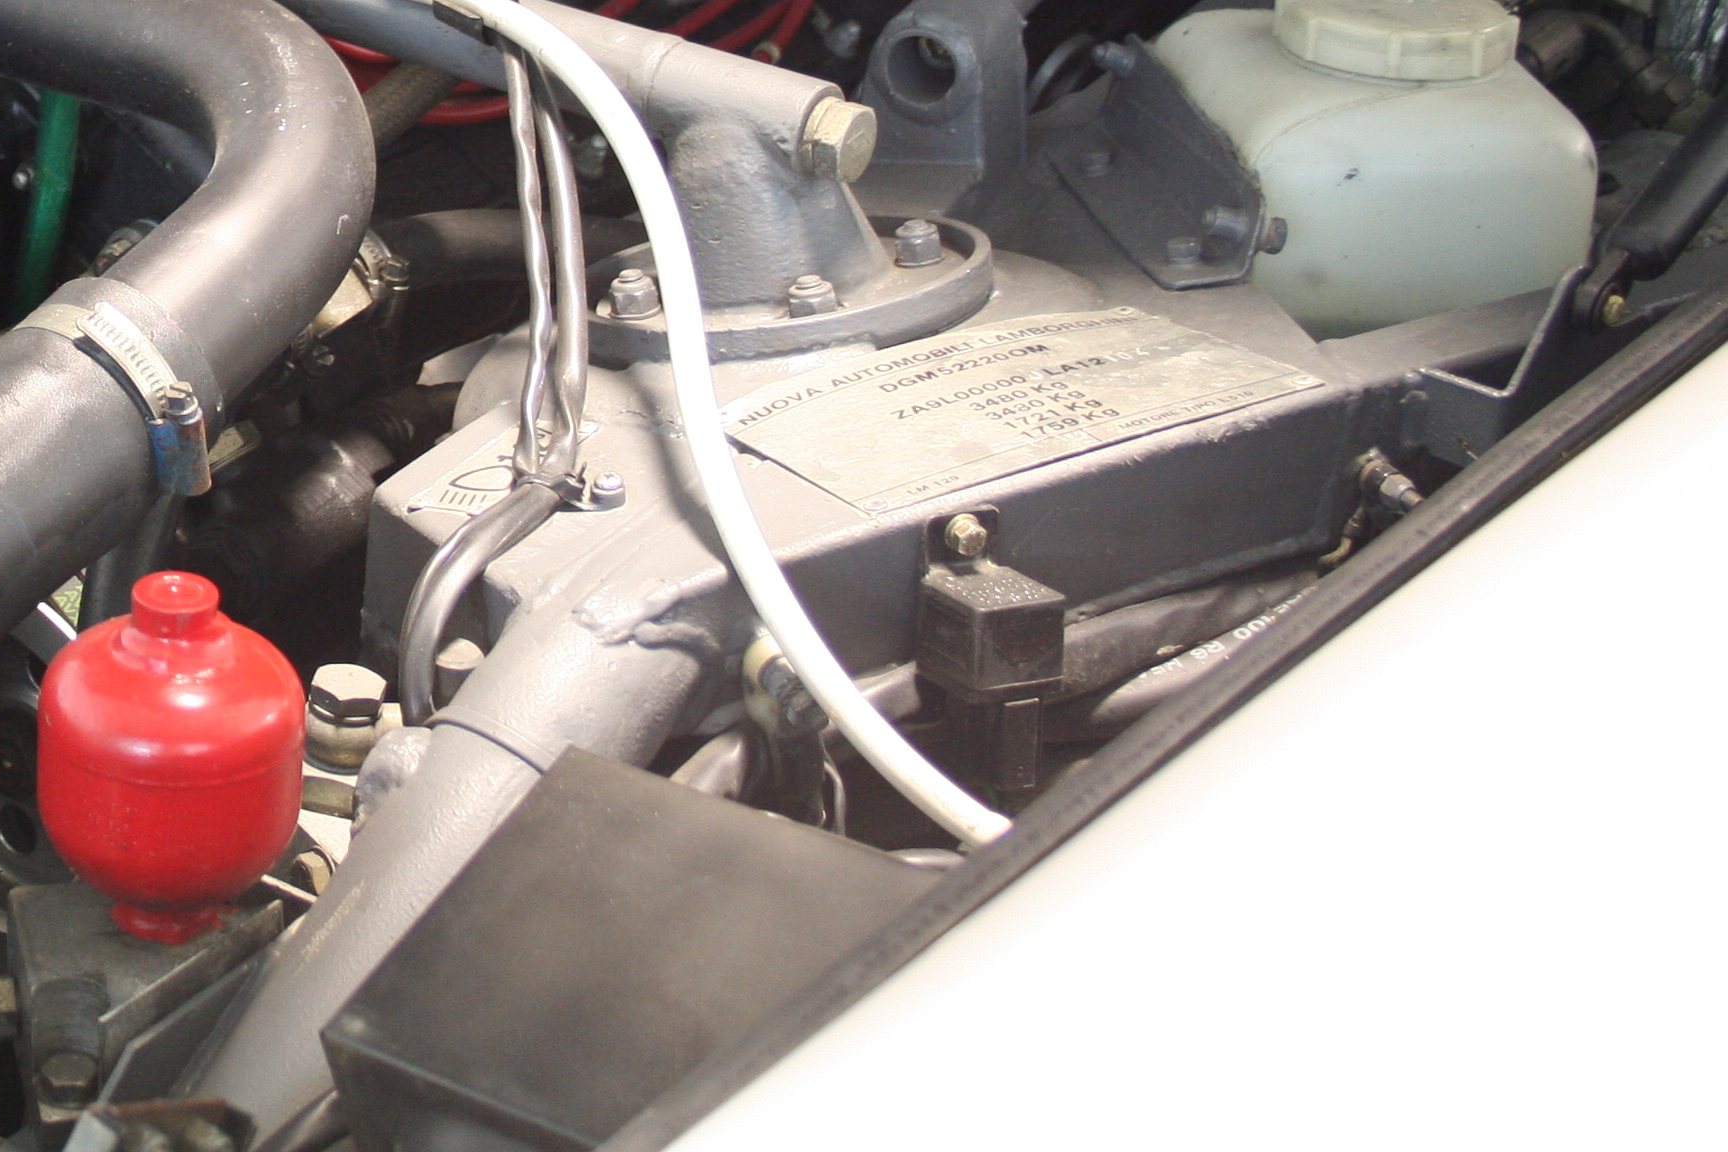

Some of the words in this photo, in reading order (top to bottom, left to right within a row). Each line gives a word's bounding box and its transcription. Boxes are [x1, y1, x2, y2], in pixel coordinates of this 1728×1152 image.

[738, 387, 822, 426] NUOVA
[830, 341, 975, 388] AUTOMOBILI
[969, 389, 1029, 411] 3480
[1030, 379, 1069, 395] Kg
[1048, 388, 1086, 405] Kg
[1003, 408, 1062, 430] 1721
[1064, 398, 1104, 414] Kg
[1020, 417, 1080, 439] 1759
[1082, 407, 1121, 423] Kg
[1117, 409, 1178, 430] MOTORE
